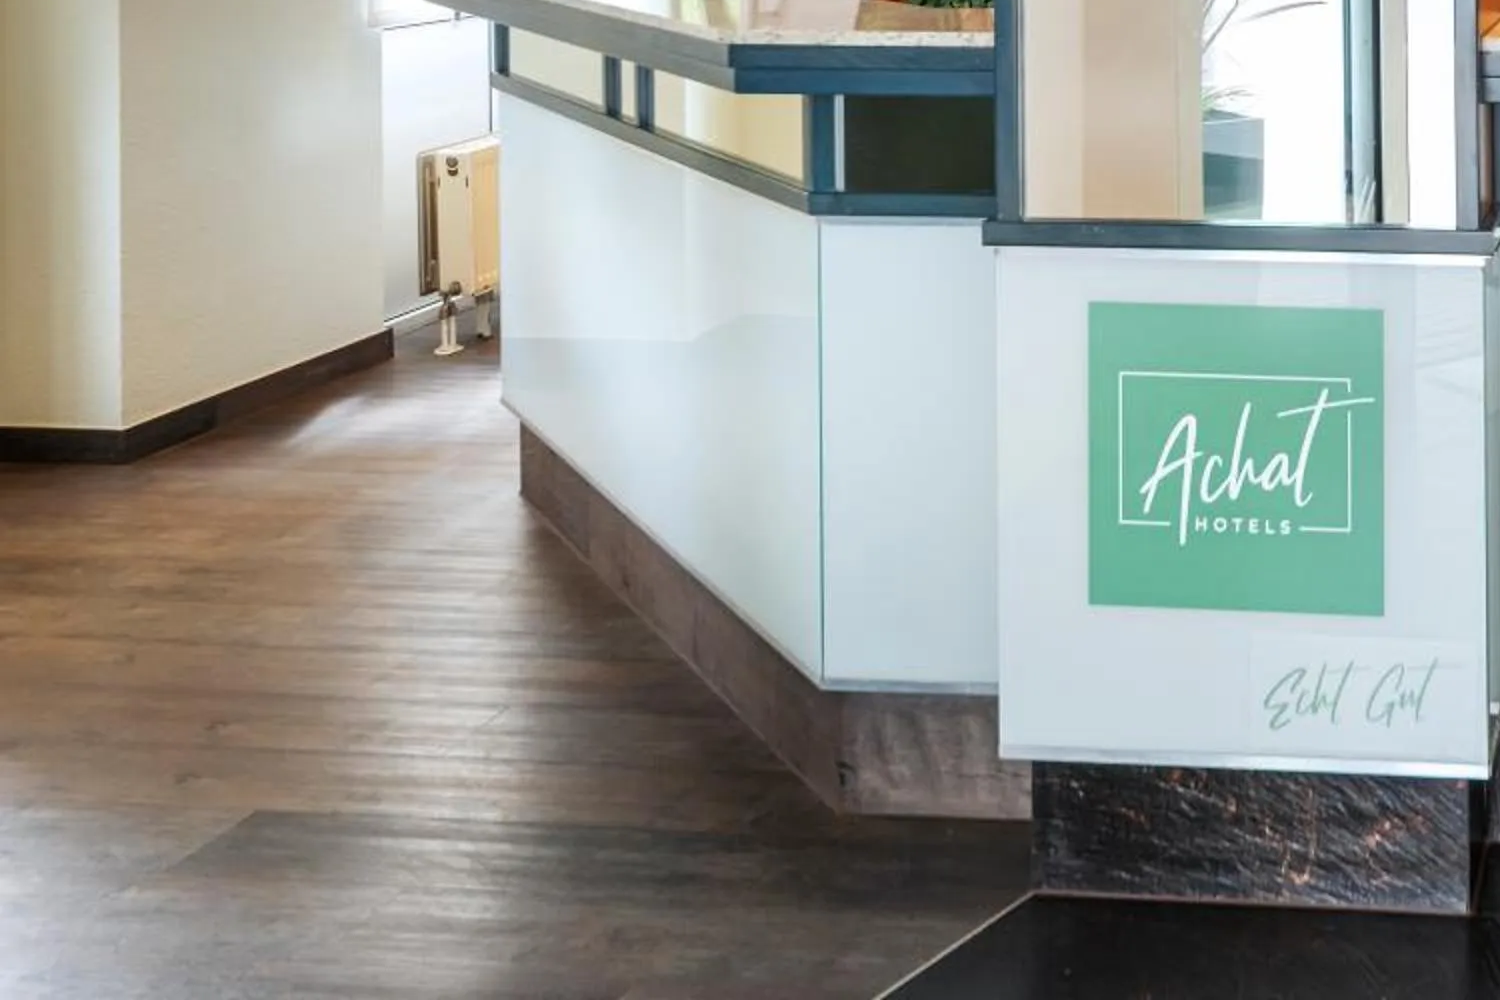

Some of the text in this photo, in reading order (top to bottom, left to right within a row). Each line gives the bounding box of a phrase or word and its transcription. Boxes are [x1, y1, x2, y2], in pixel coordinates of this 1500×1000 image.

[1139, 387, 1376, 547] Achat
[1194, 516, 1292, 535] HOTELS
[1263, 656, 1463, 731] Echt Gut
